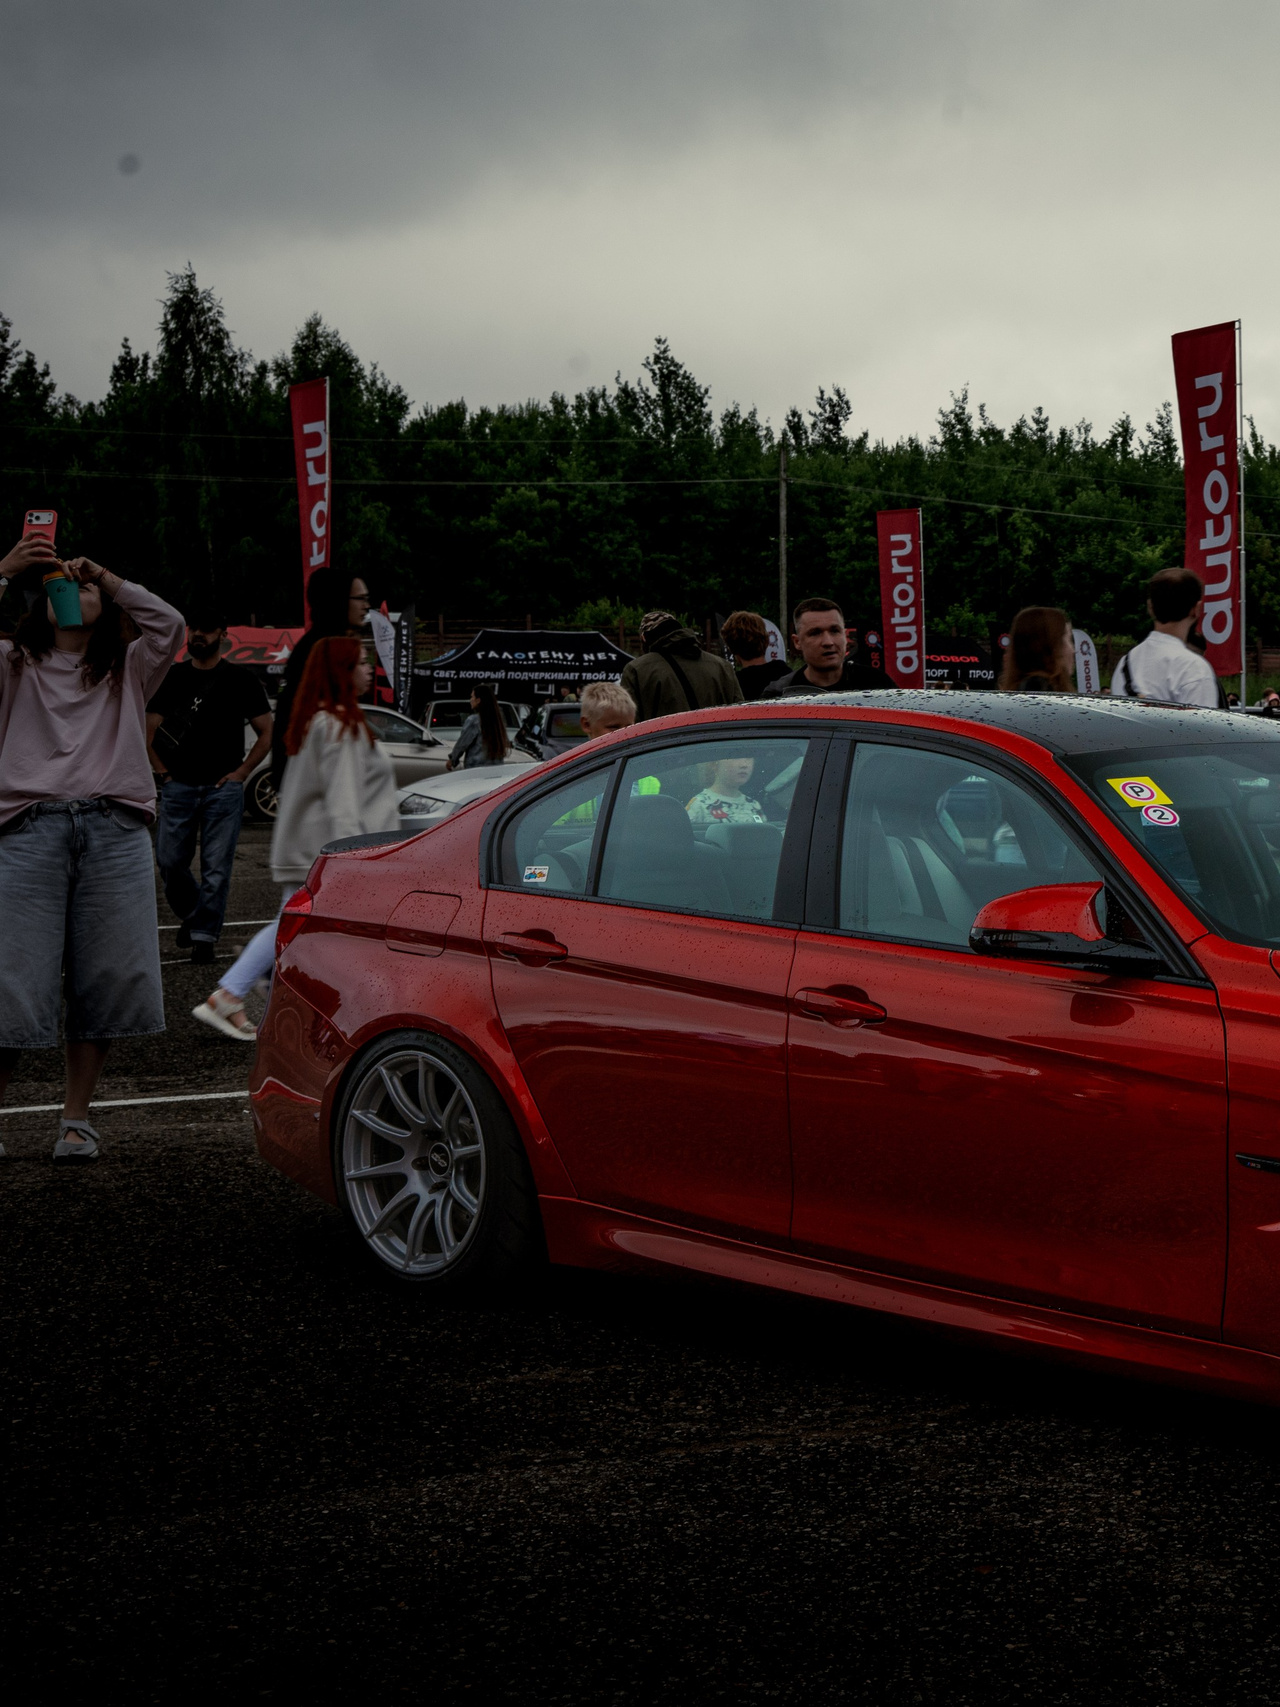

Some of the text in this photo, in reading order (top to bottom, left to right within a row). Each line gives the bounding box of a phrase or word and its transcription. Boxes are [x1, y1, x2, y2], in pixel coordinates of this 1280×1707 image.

[302, 420, 329, 567] to.ru
[1195, 371, 1233, 645] auto.ru
[890, 533, 919, 674] auto.ru
[583, 652, 618, 661] NET
[925, 654, 980, 664] ODBOR
[459, 669, 506, 680] КОТОРЫЙ
[507, 671, 580, 681] ПОДЧЕРКИВАЕТ
[581, 670, 606, 680] ТВОЙ
[1128, 785, 1145, 797] P
[1152, 809, 1170, 821] 2
